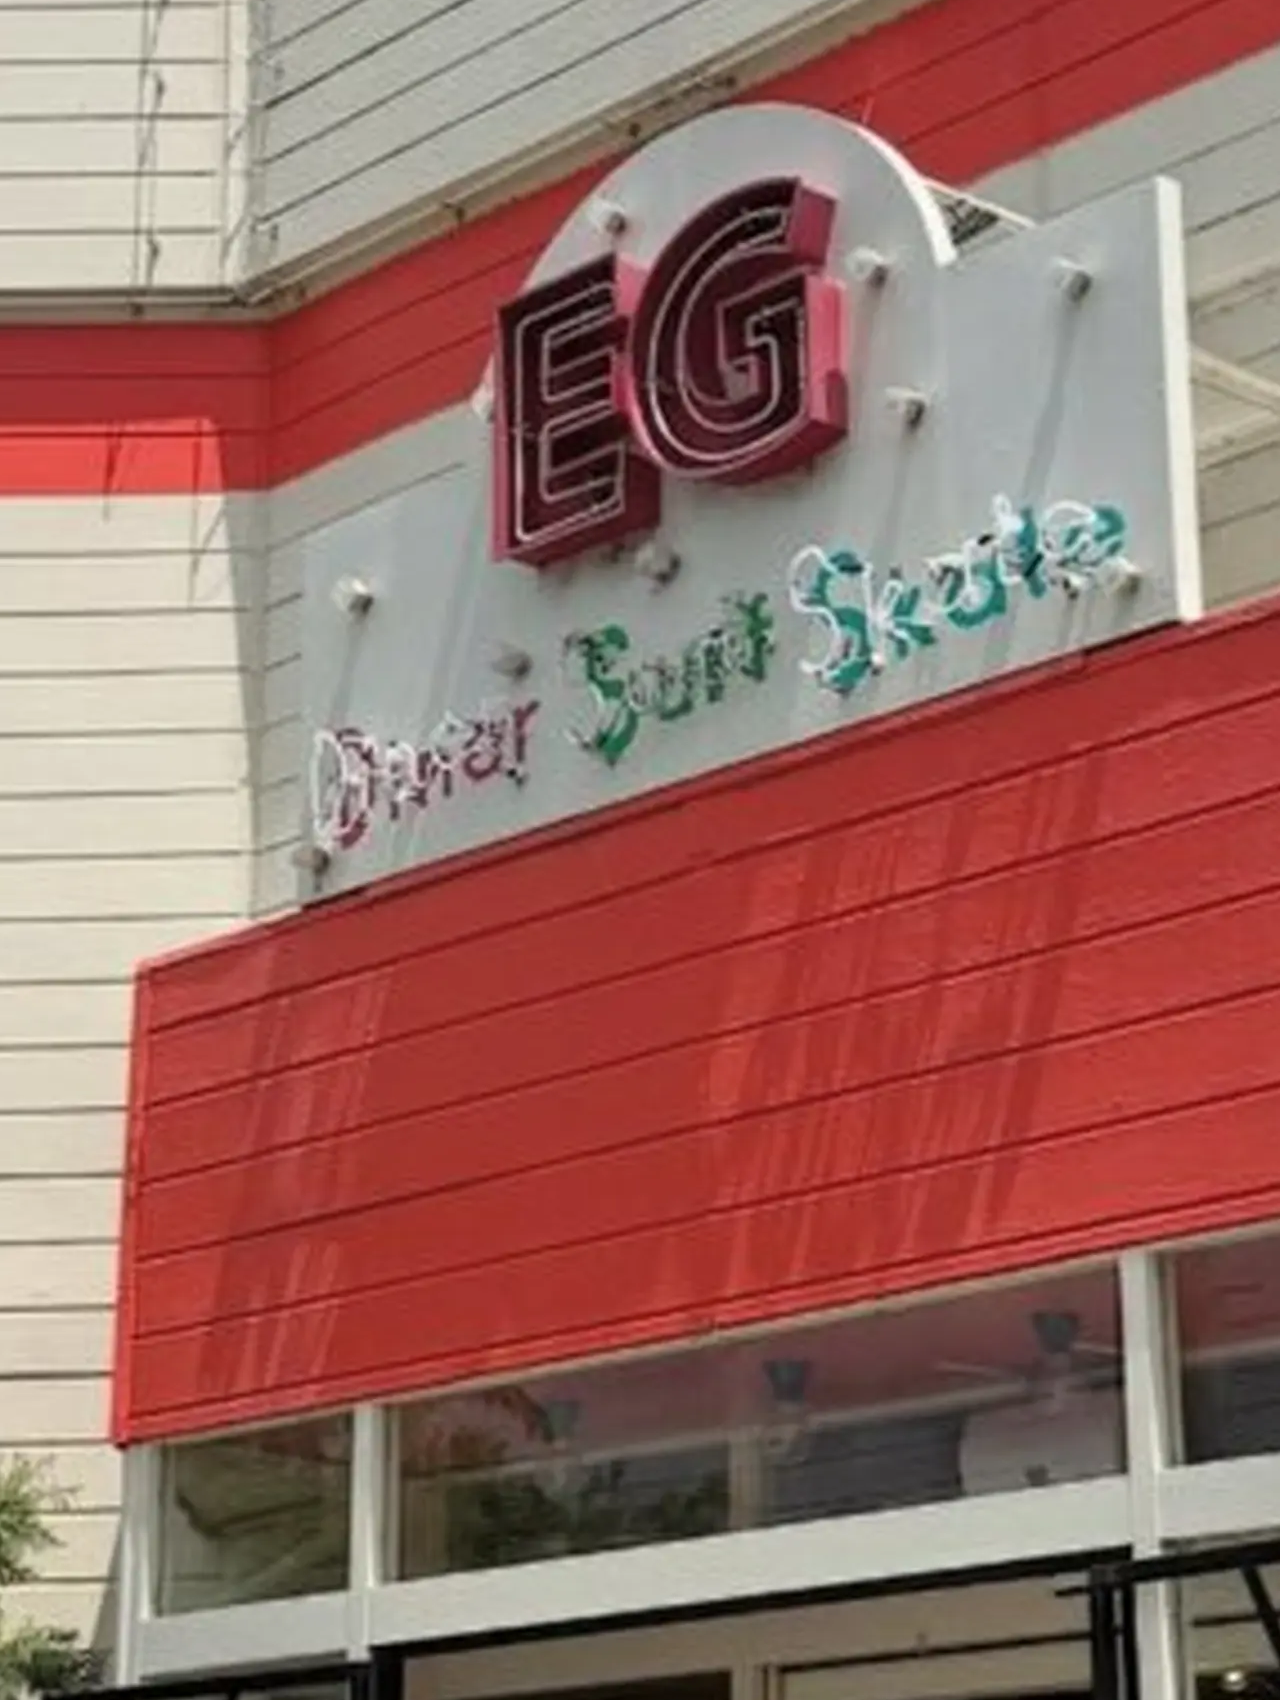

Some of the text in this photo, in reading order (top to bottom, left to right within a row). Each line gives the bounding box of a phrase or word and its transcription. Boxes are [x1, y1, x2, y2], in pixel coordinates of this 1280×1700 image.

[493, 176, 849, 569] EG
[310, 494, 1127, 850] Diner Surf Skate
